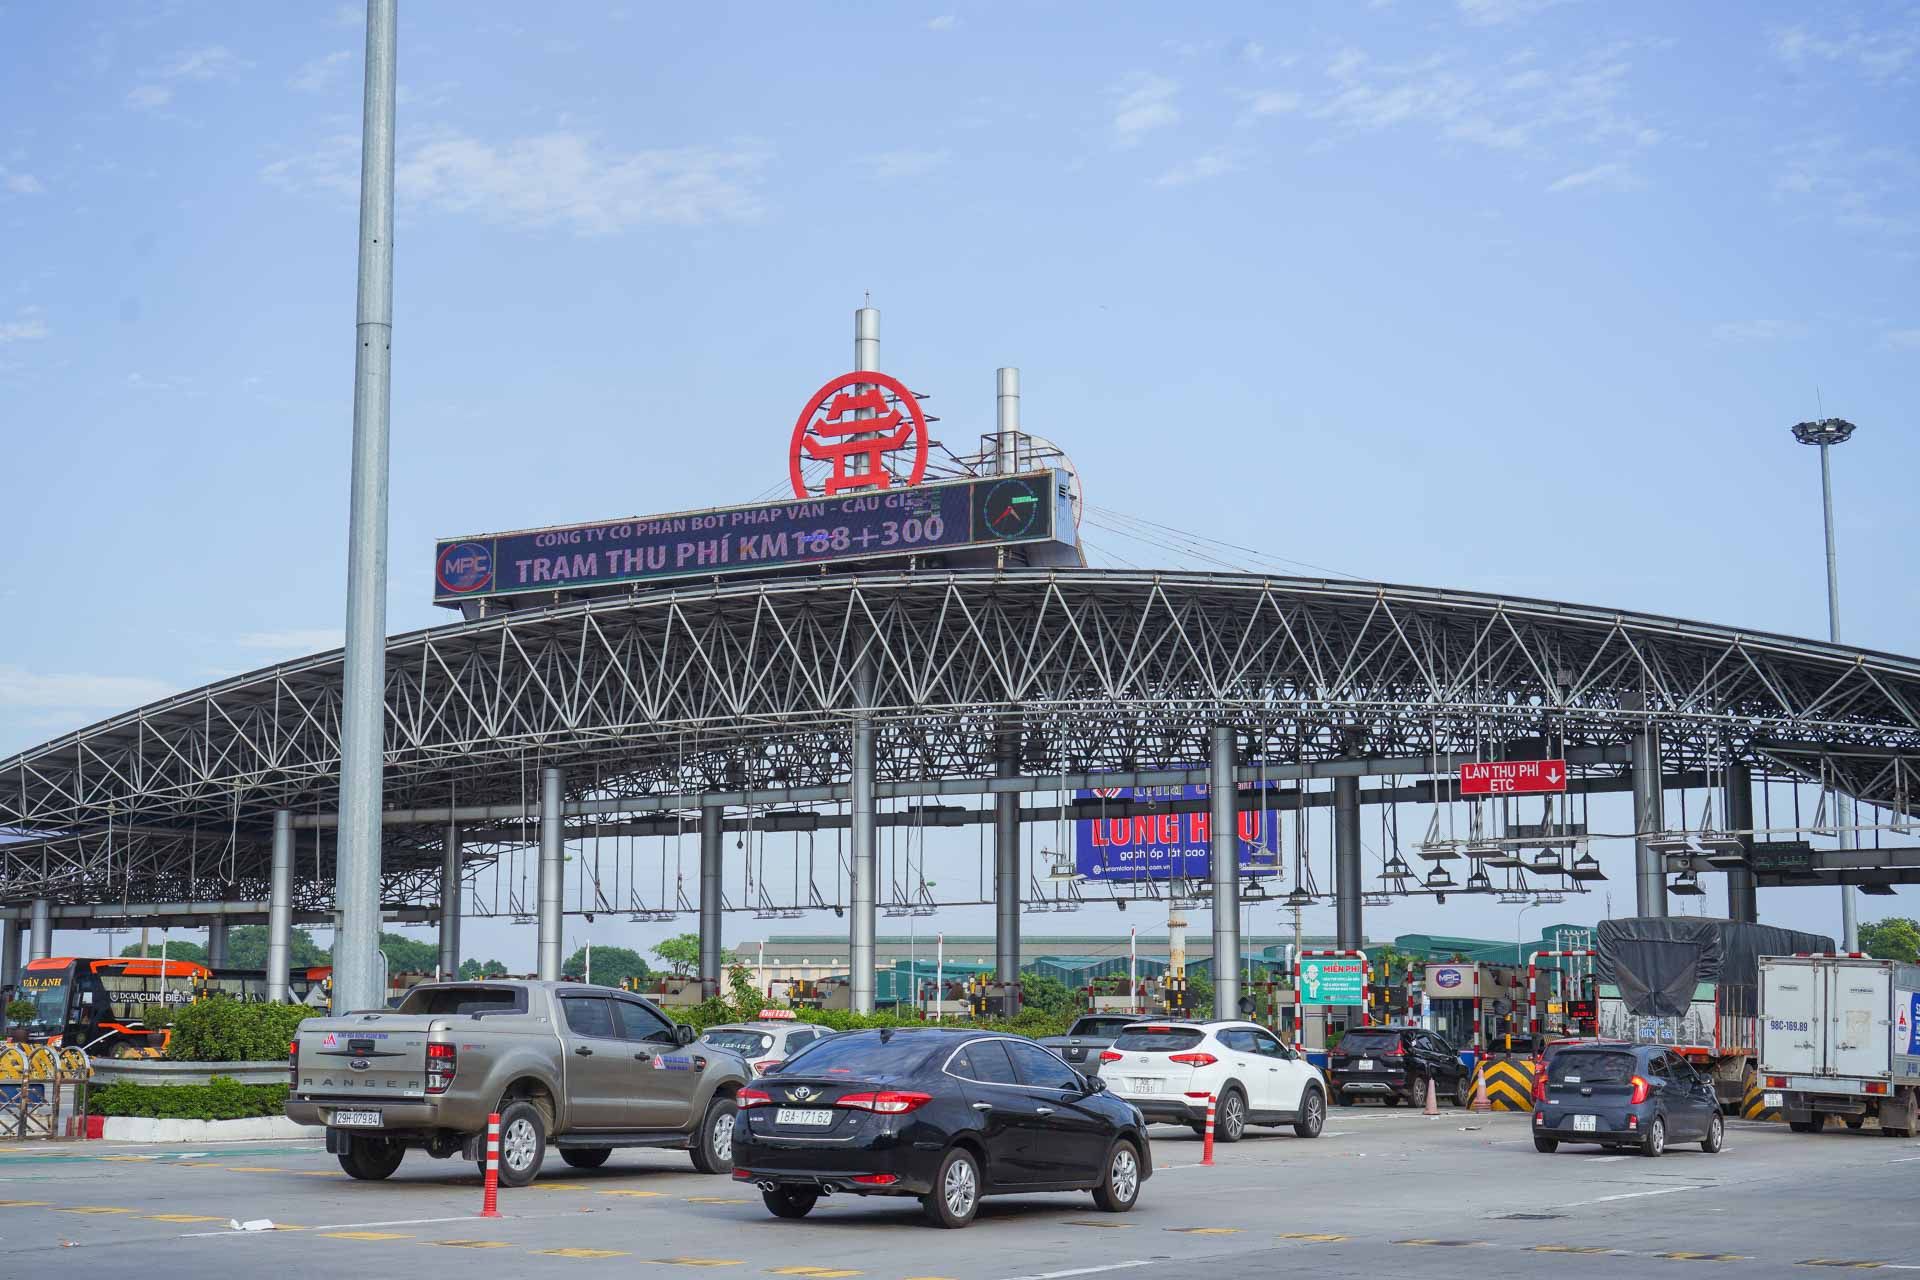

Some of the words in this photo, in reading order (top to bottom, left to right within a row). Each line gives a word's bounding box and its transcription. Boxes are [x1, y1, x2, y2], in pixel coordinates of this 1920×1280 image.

[585, 526, 607, 542] TY
[691, 514, 728, 531] BOT
[605, 544, 667, 574] THU
[676, 533, 732, 568] PHÍ
[445, 555, 488, 575] MPC
[1465, 763, 1489, 779] LÀN
[1492, 765, 1516, 778] THU
[1519, 760, 1539, 777] PHÍ
[1490, 779, 1514, 792] ETC
[1190, 809, 1260, 843] HU
[1185, 849, 1206, 857] cao
[40, 977, 62, 987] ANH
[1438, 973, 1460, 982] MPC
[1770, 1020, 1808, 1032] 98C-169.89
[303, 1078, 420, 1089] RANGER
